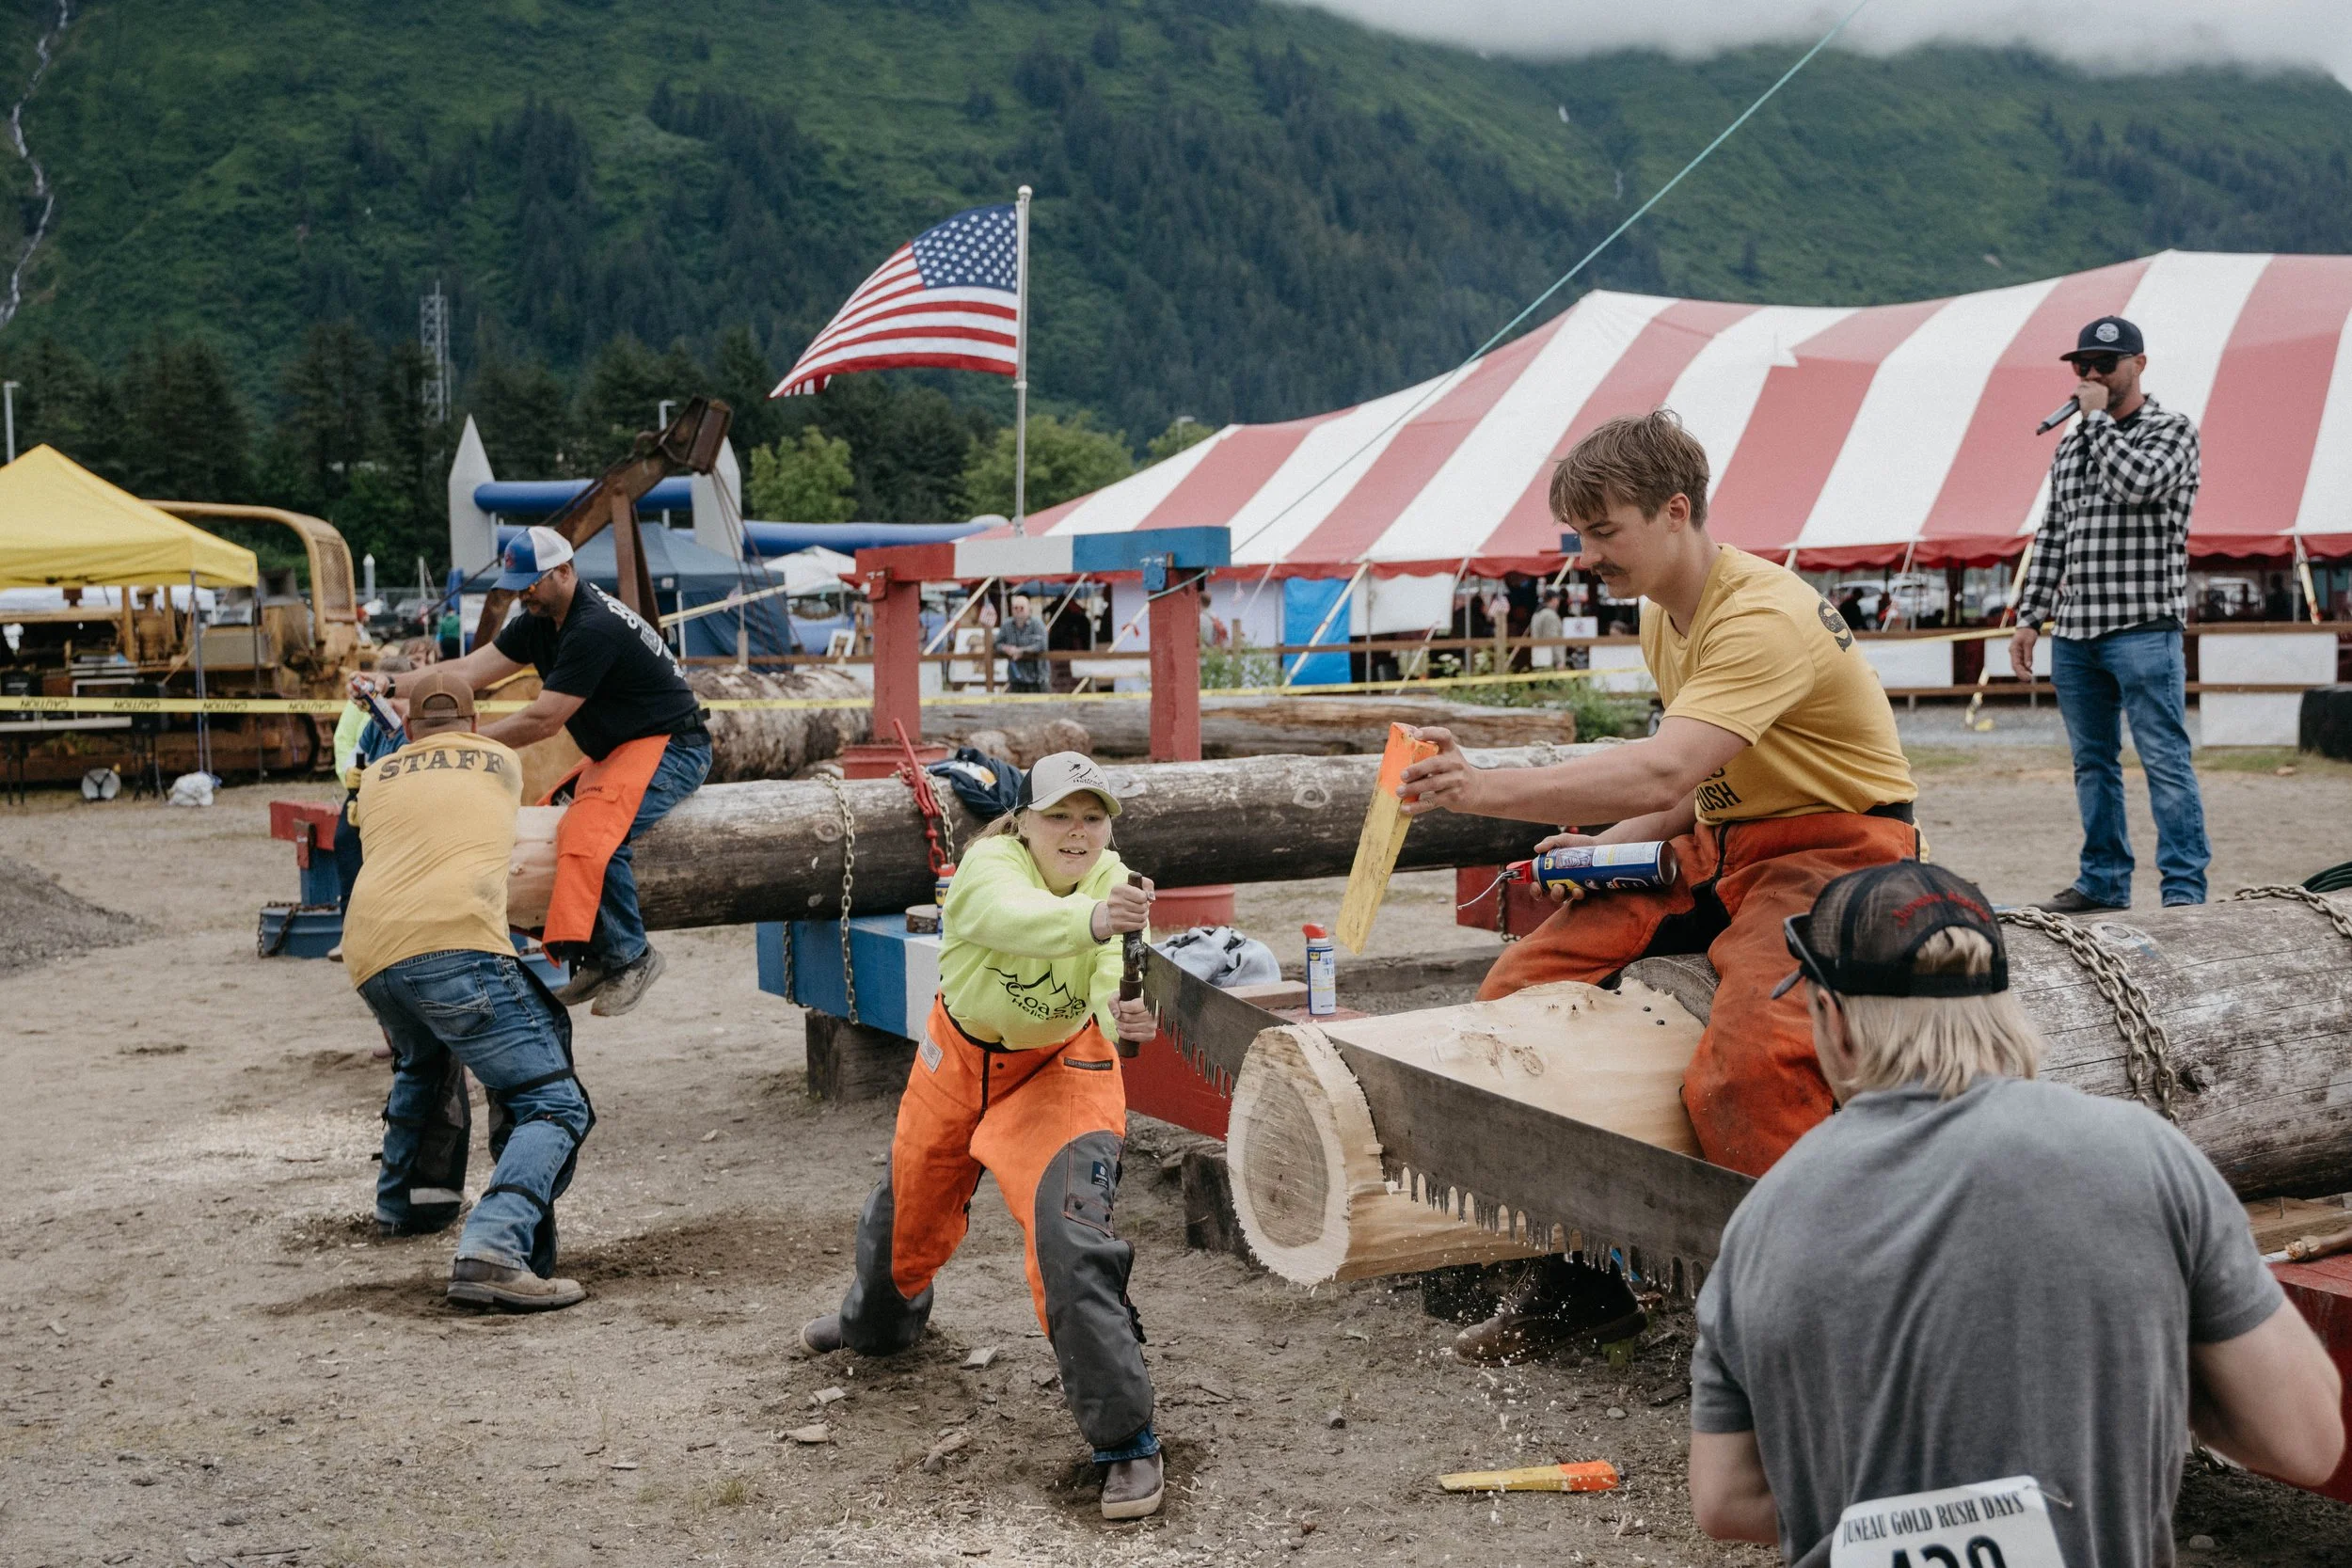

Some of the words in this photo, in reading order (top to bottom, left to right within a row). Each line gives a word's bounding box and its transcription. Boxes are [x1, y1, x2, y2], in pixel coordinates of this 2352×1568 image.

[21, 699, 69, 710] CAUTION
[114, 699, 160, 712] CAUTION
[378, 750, 505, 782] STAFF
[1843, 1514, 1887, 1547] JUNEAU
[1891, 1508, 1933, 1535] GOLD
[1935, 1499, 1979, 1528] RUSH
[1980, 1491, 2025, 1519] DAYS
